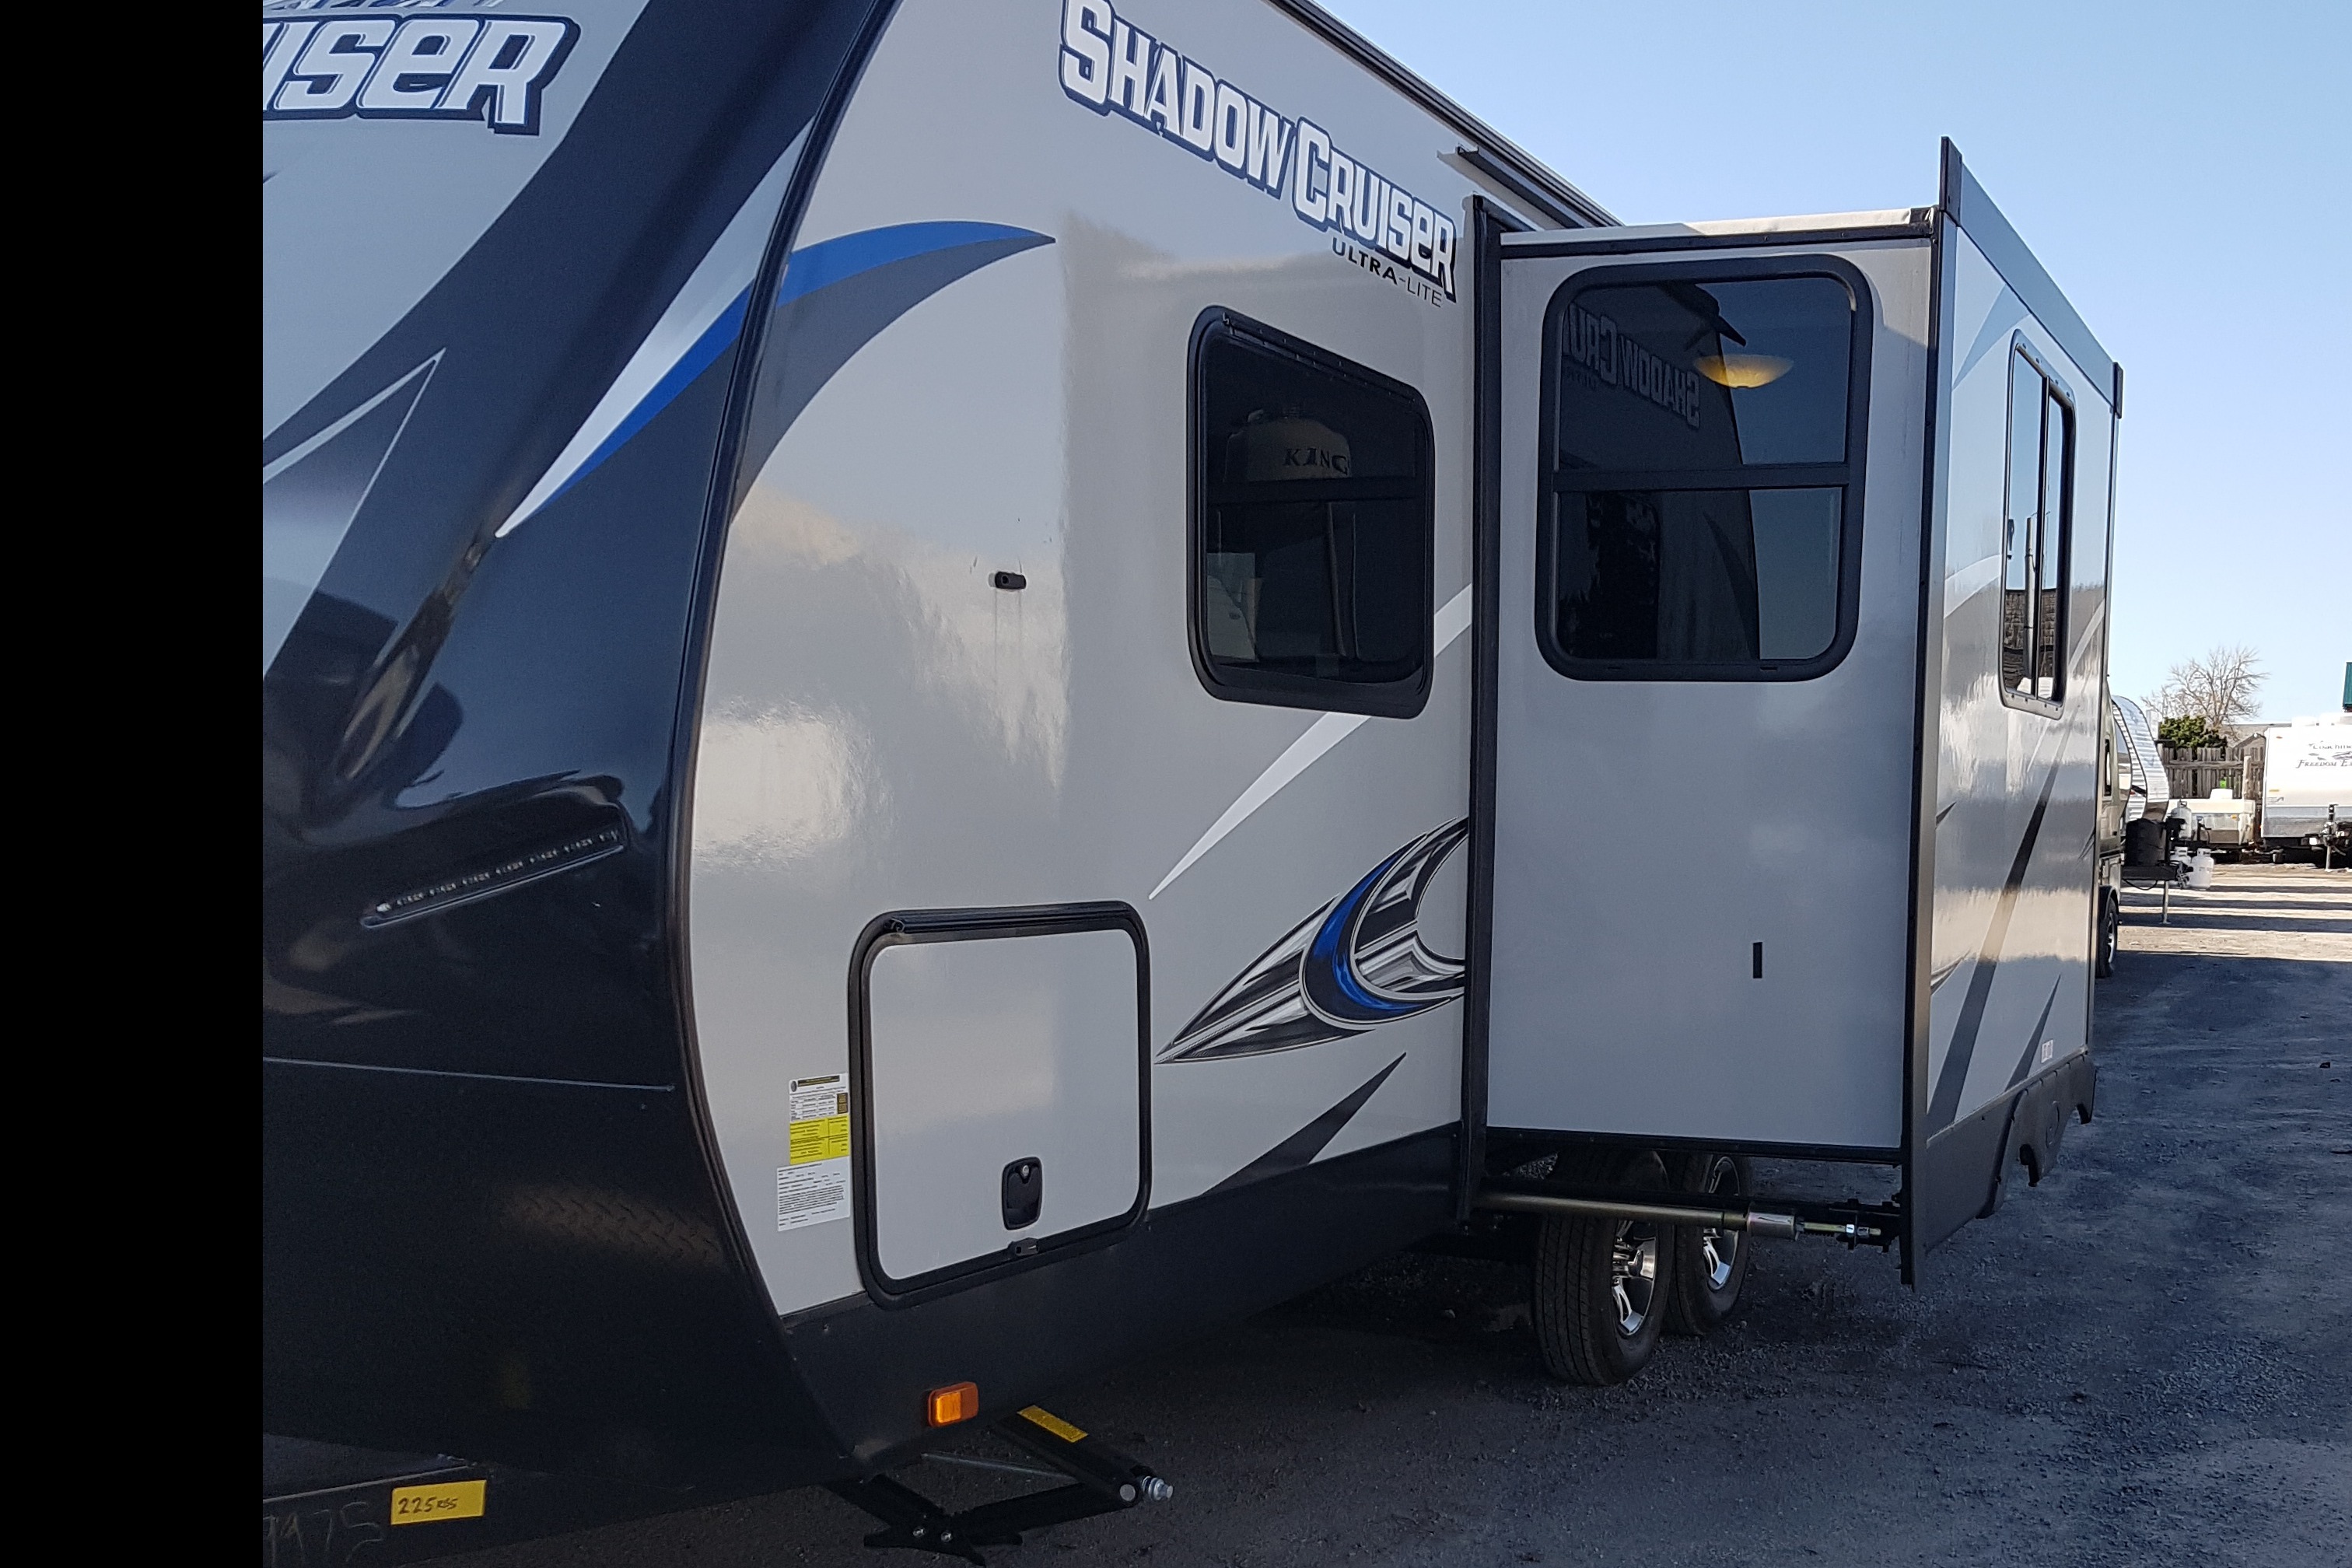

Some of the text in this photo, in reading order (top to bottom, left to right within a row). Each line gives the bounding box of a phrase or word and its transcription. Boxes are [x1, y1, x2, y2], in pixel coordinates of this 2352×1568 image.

[263, 13, 581, 136] ISER
[1059, 0, 1457, 303] SHADOW CRUISER
[1332, 236, 1444, 308] ULTRA-LITE
